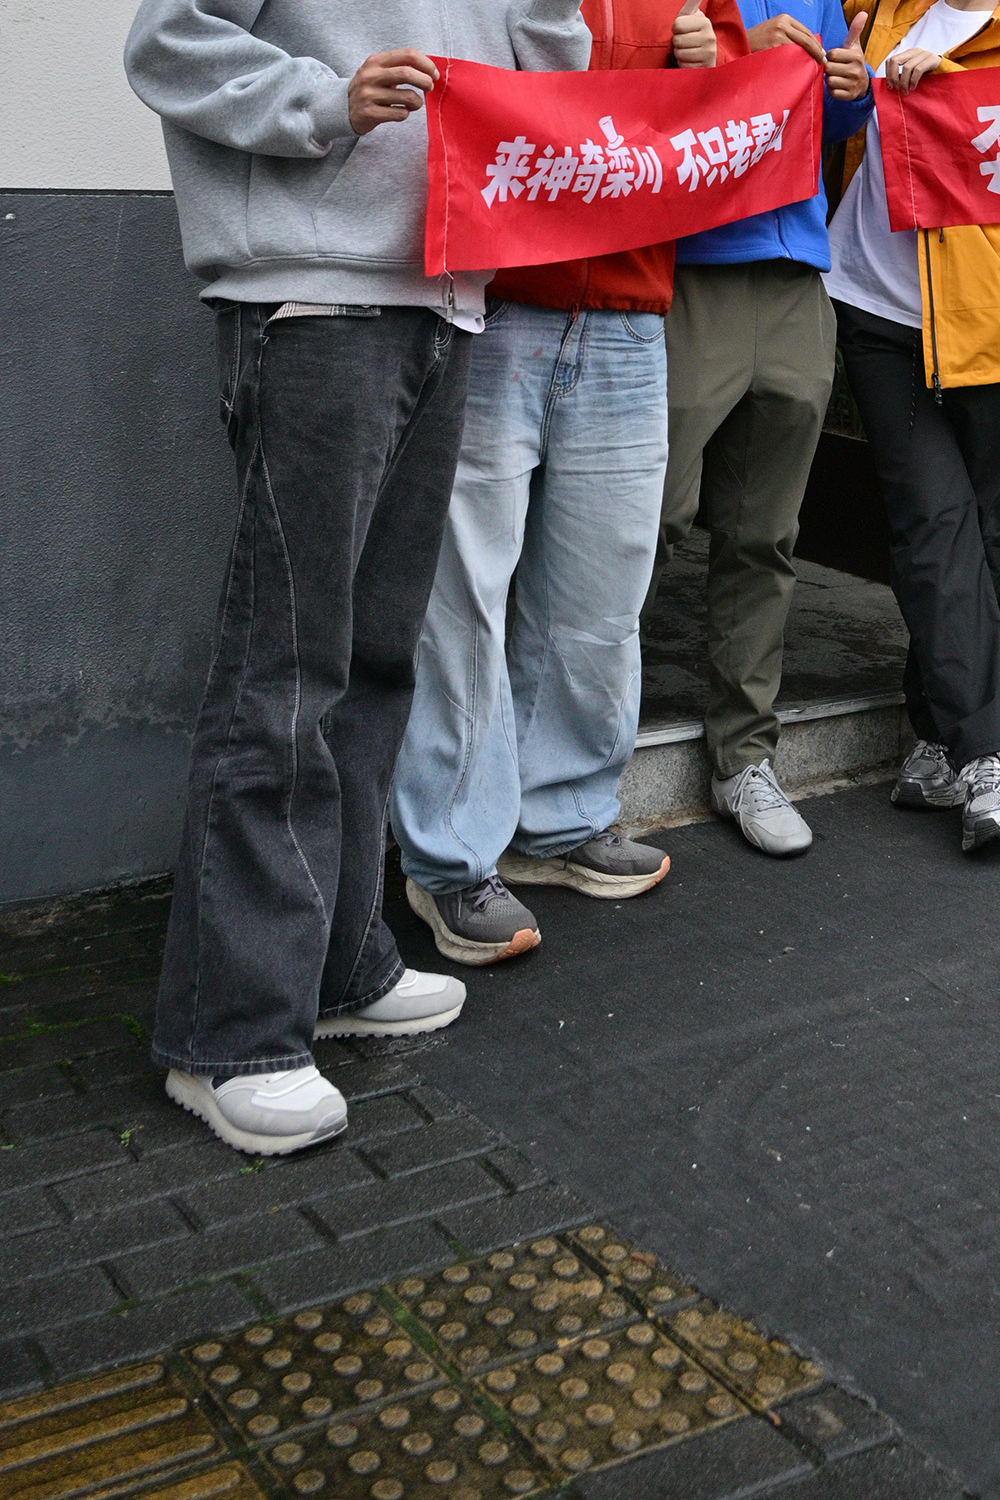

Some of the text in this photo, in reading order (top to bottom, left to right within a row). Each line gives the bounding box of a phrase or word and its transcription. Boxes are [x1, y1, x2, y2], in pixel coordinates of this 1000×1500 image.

[481, 109, 790, 209] 来神奇栾川 不只老君山
